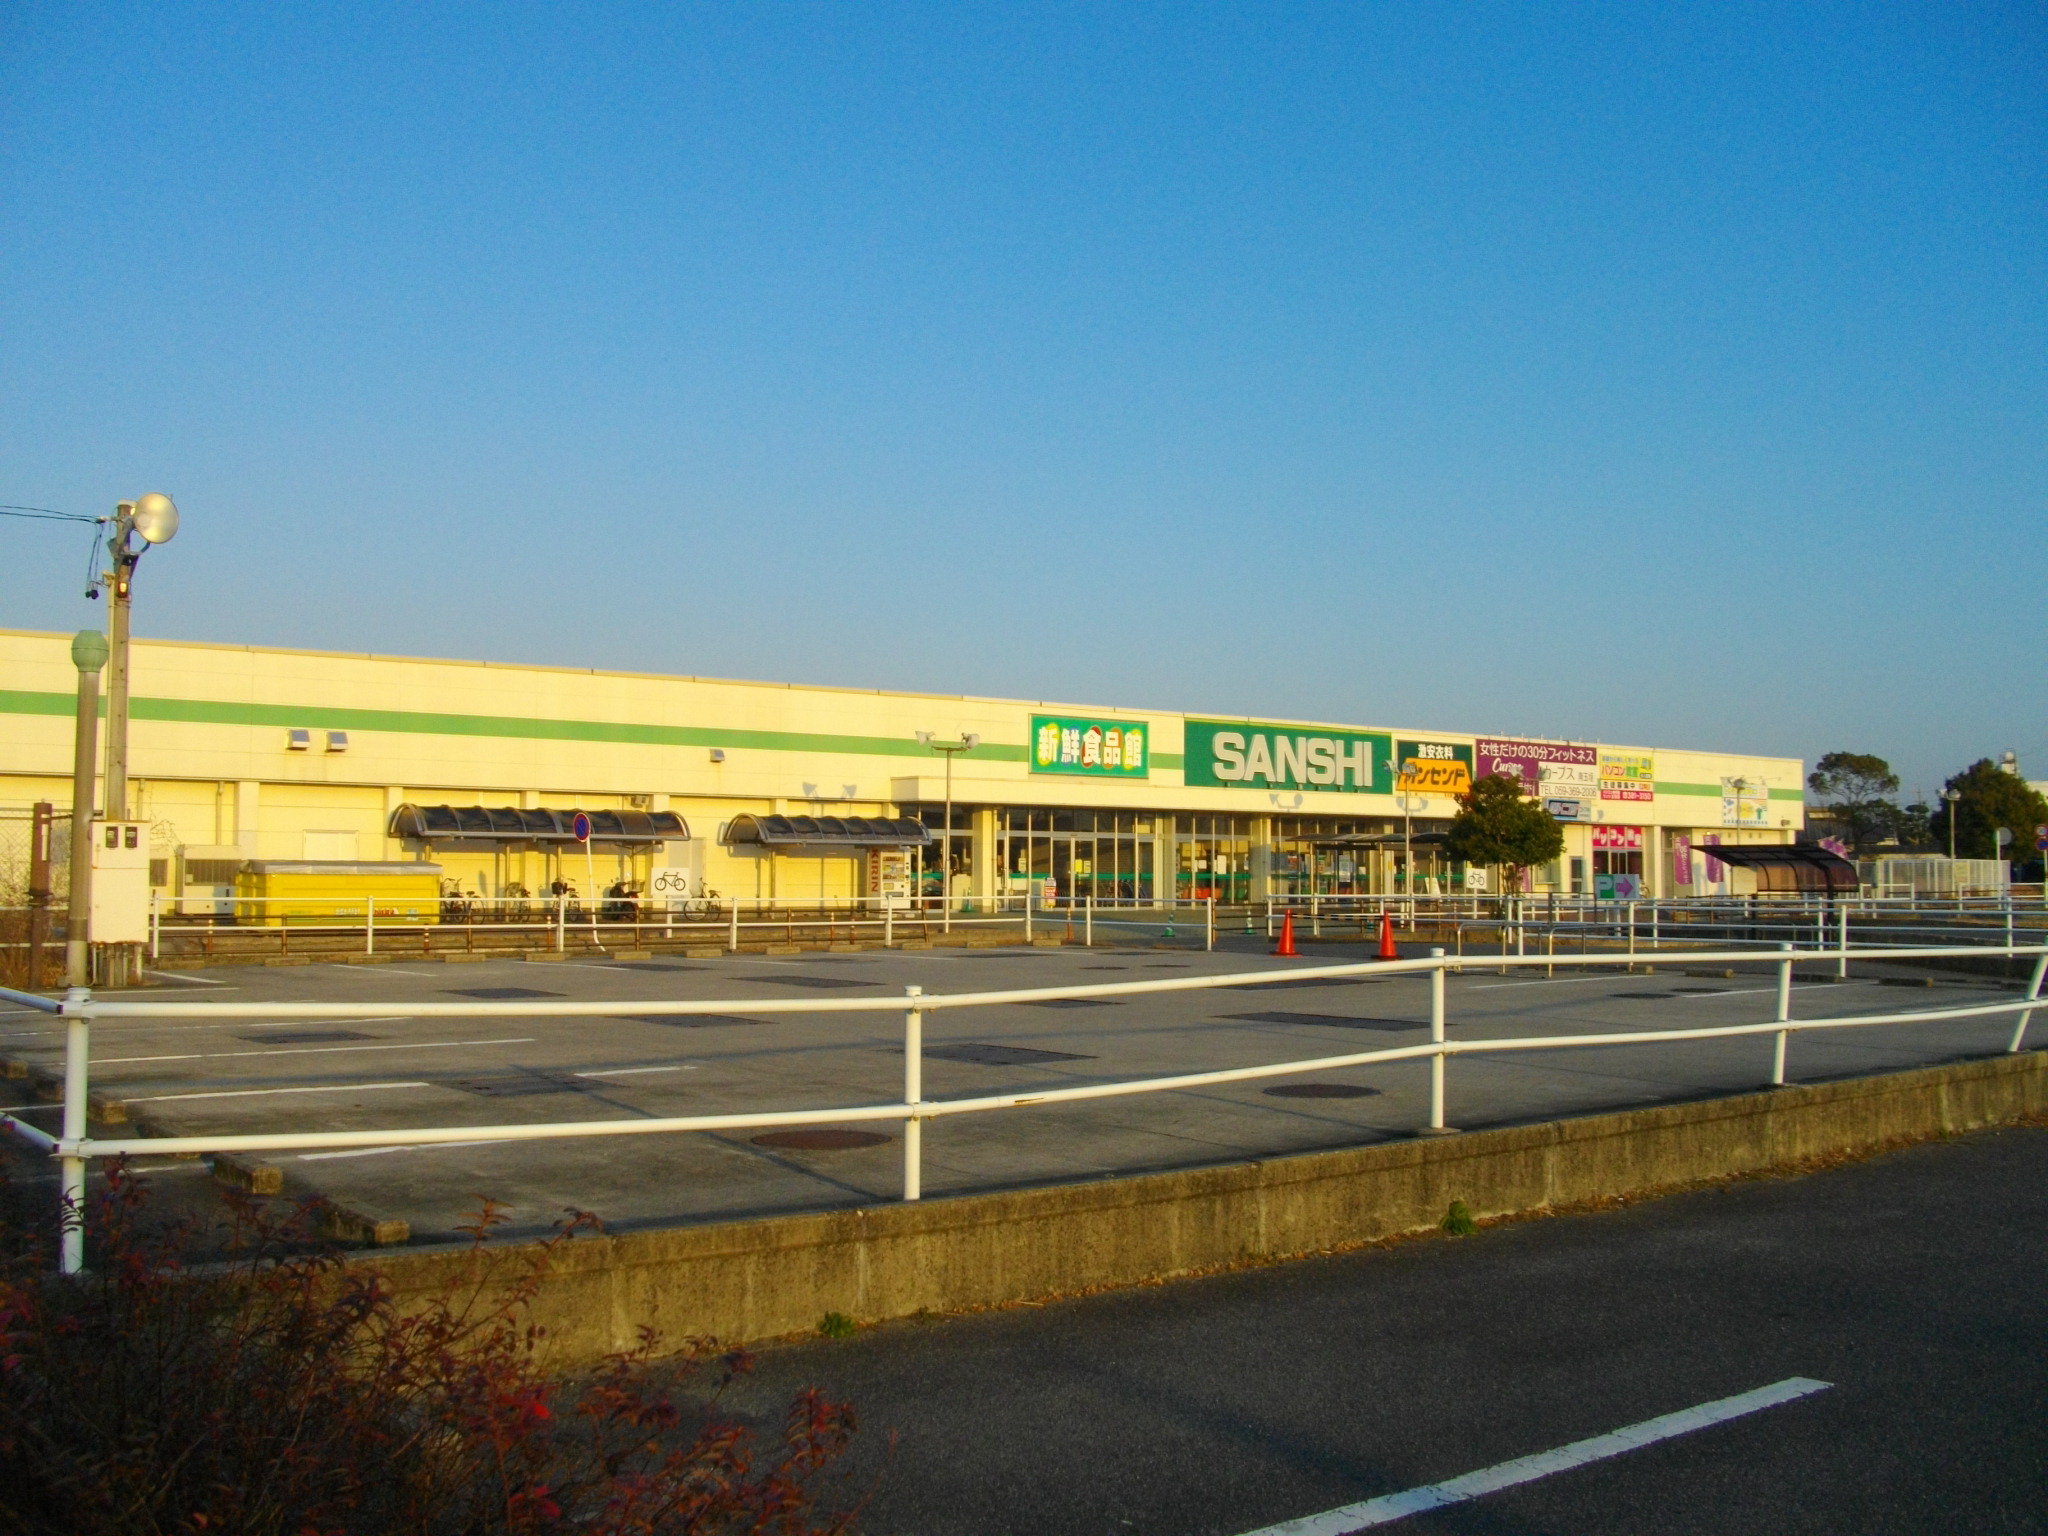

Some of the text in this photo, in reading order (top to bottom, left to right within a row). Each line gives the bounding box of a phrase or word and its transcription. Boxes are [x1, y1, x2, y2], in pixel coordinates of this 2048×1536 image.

[1038, 726, 1142, 767] 新鮮食品館
[1212, 731, 1373, 787] SANSHI
[1417, 743, 1454, 760] 激安衣料
[1479, 742, 1596, 763] 女性だけの30分フィットネス
[871, 848, 879, 893] KIRIN
[1596, 876, 1614, 899] P
